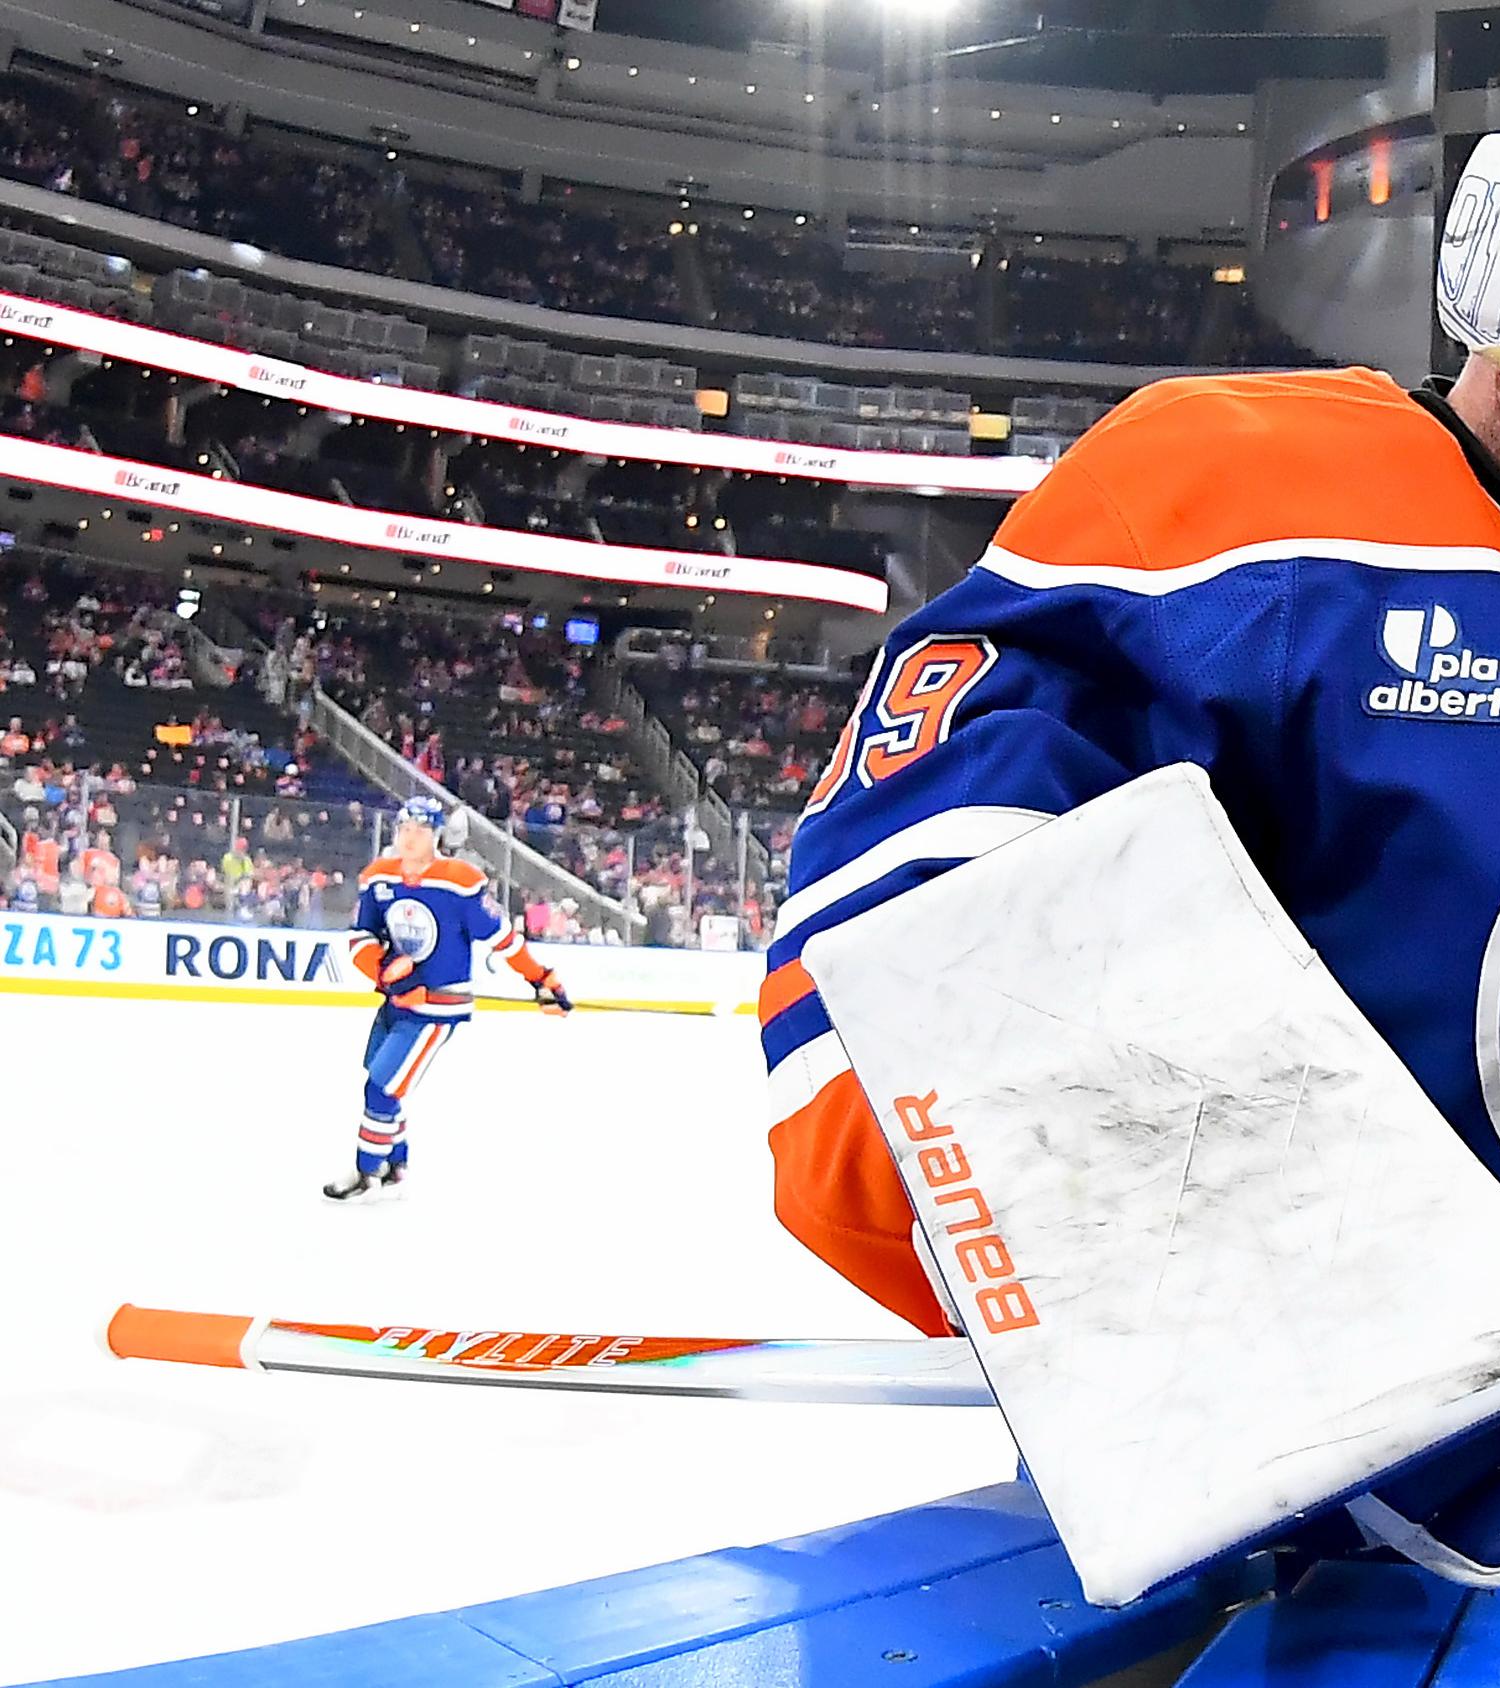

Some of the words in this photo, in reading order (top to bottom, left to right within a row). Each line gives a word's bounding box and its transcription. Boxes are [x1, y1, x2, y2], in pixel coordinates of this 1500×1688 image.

[4, 923, 57, 967] ZA
[72, 927, 122, 970] 73
[165, 932, 343, 983] RONA
